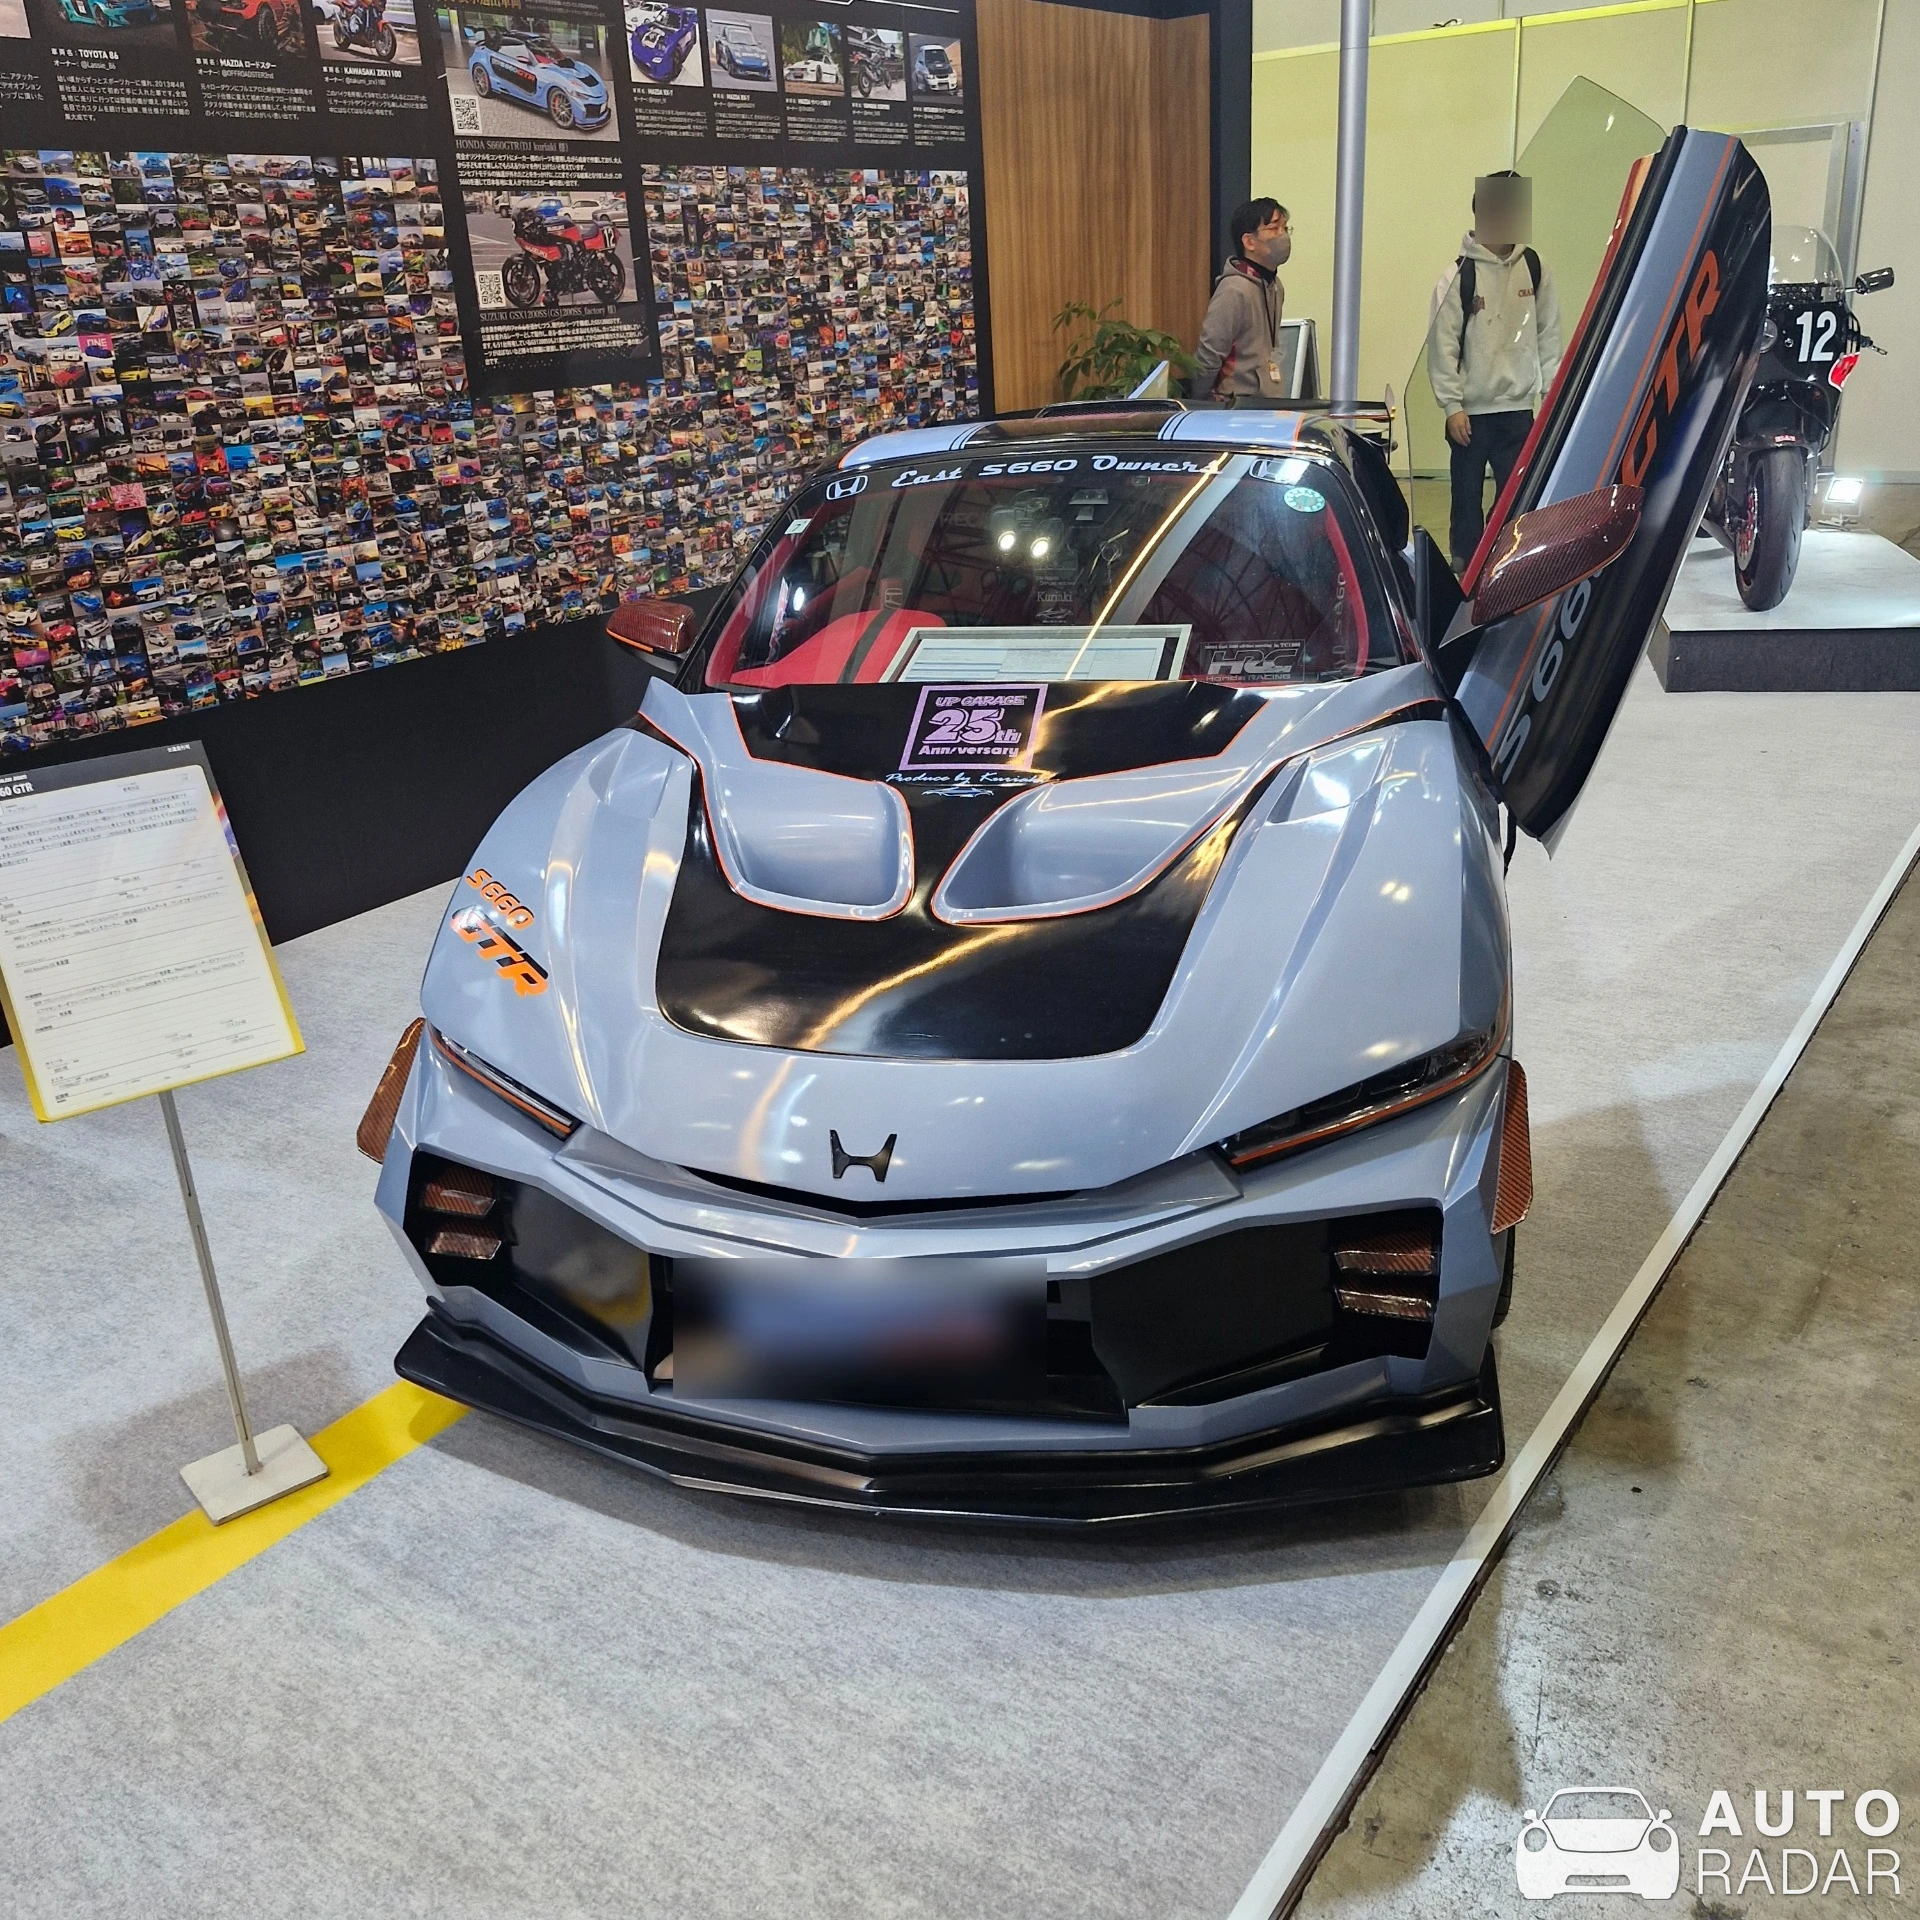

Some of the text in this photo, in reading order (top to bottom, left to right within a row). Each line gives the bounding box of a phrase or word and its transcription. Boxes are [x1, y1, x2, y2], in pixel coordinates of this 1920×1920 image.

[78, 49, 108, 59] TOYOTA
[108, 51, 120, 60] 86
[219, 58, 244, 68] MAZDA
[343, 66, 376, 77] KAWASAKI
[455, 139, 485, 150] HONDA
[603, 227, 616, 248] 12
[480, 311, 508, 322] SUZUKI
[1796, 310, 1837, 363] 12
[1622, 250, 1721, 487] GTR
[892, 455, 1223, 488] East S660 Owners
[1207, 649, 1298, 674] HRC
[1206, 674, 1246, 682] Honda
[935, 695, 1027, 707] UP GARAGE
[922, 708, 1022, 744] 25th
[918, 745, 1019, 758] Anniversary
[885, 772, 951, 784] Produce
[953, 772, 971, 786] by
[13, 782, 34, 795] GTR
[465, 868, 535, 931] S660
[450, 904, 549, 998] GTR
